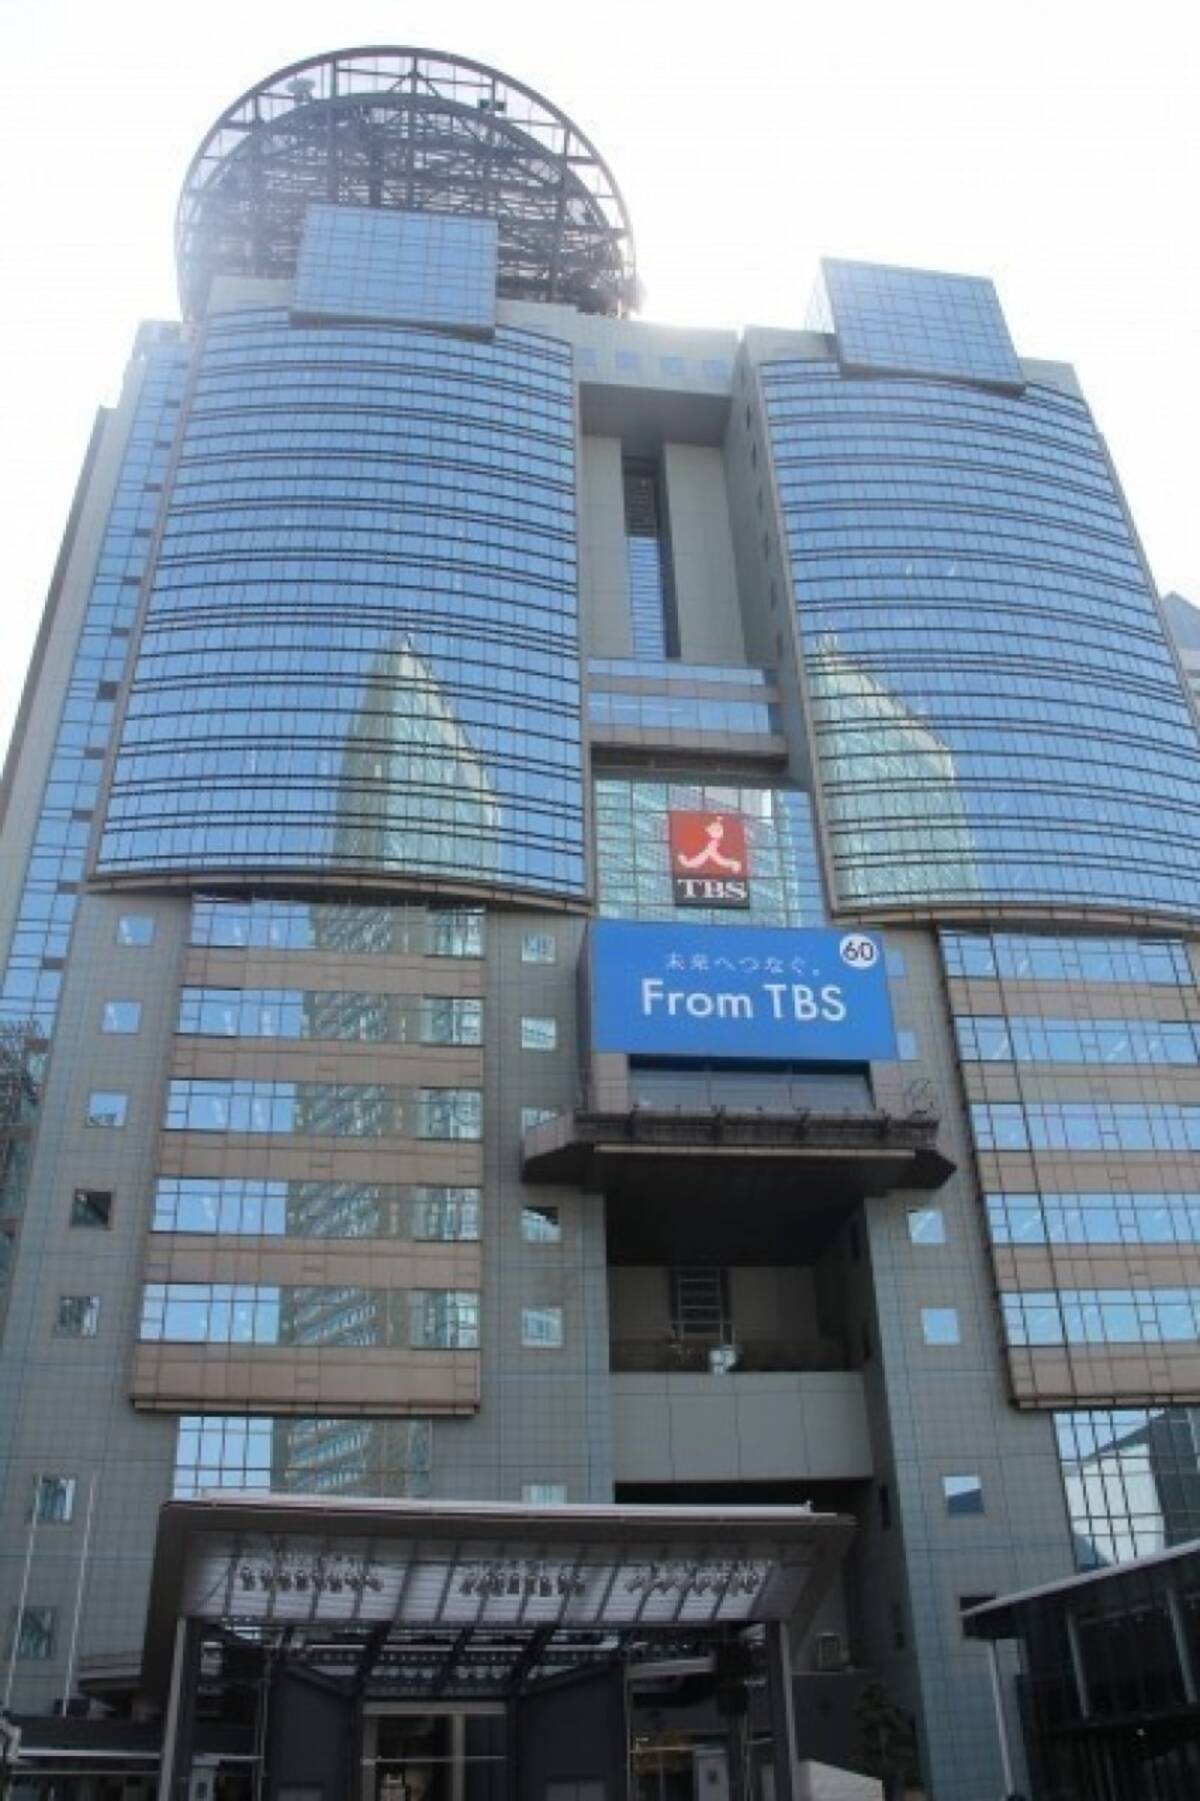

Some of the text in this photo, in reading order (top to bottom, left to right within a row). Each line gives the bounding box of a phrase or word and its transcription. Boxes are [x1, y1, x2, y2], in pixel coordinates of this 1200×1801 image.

[677, 879, 747, 899] TBS
[842, 942, 874, 961] 60
[641, 978, 847, 1022] From TBS
